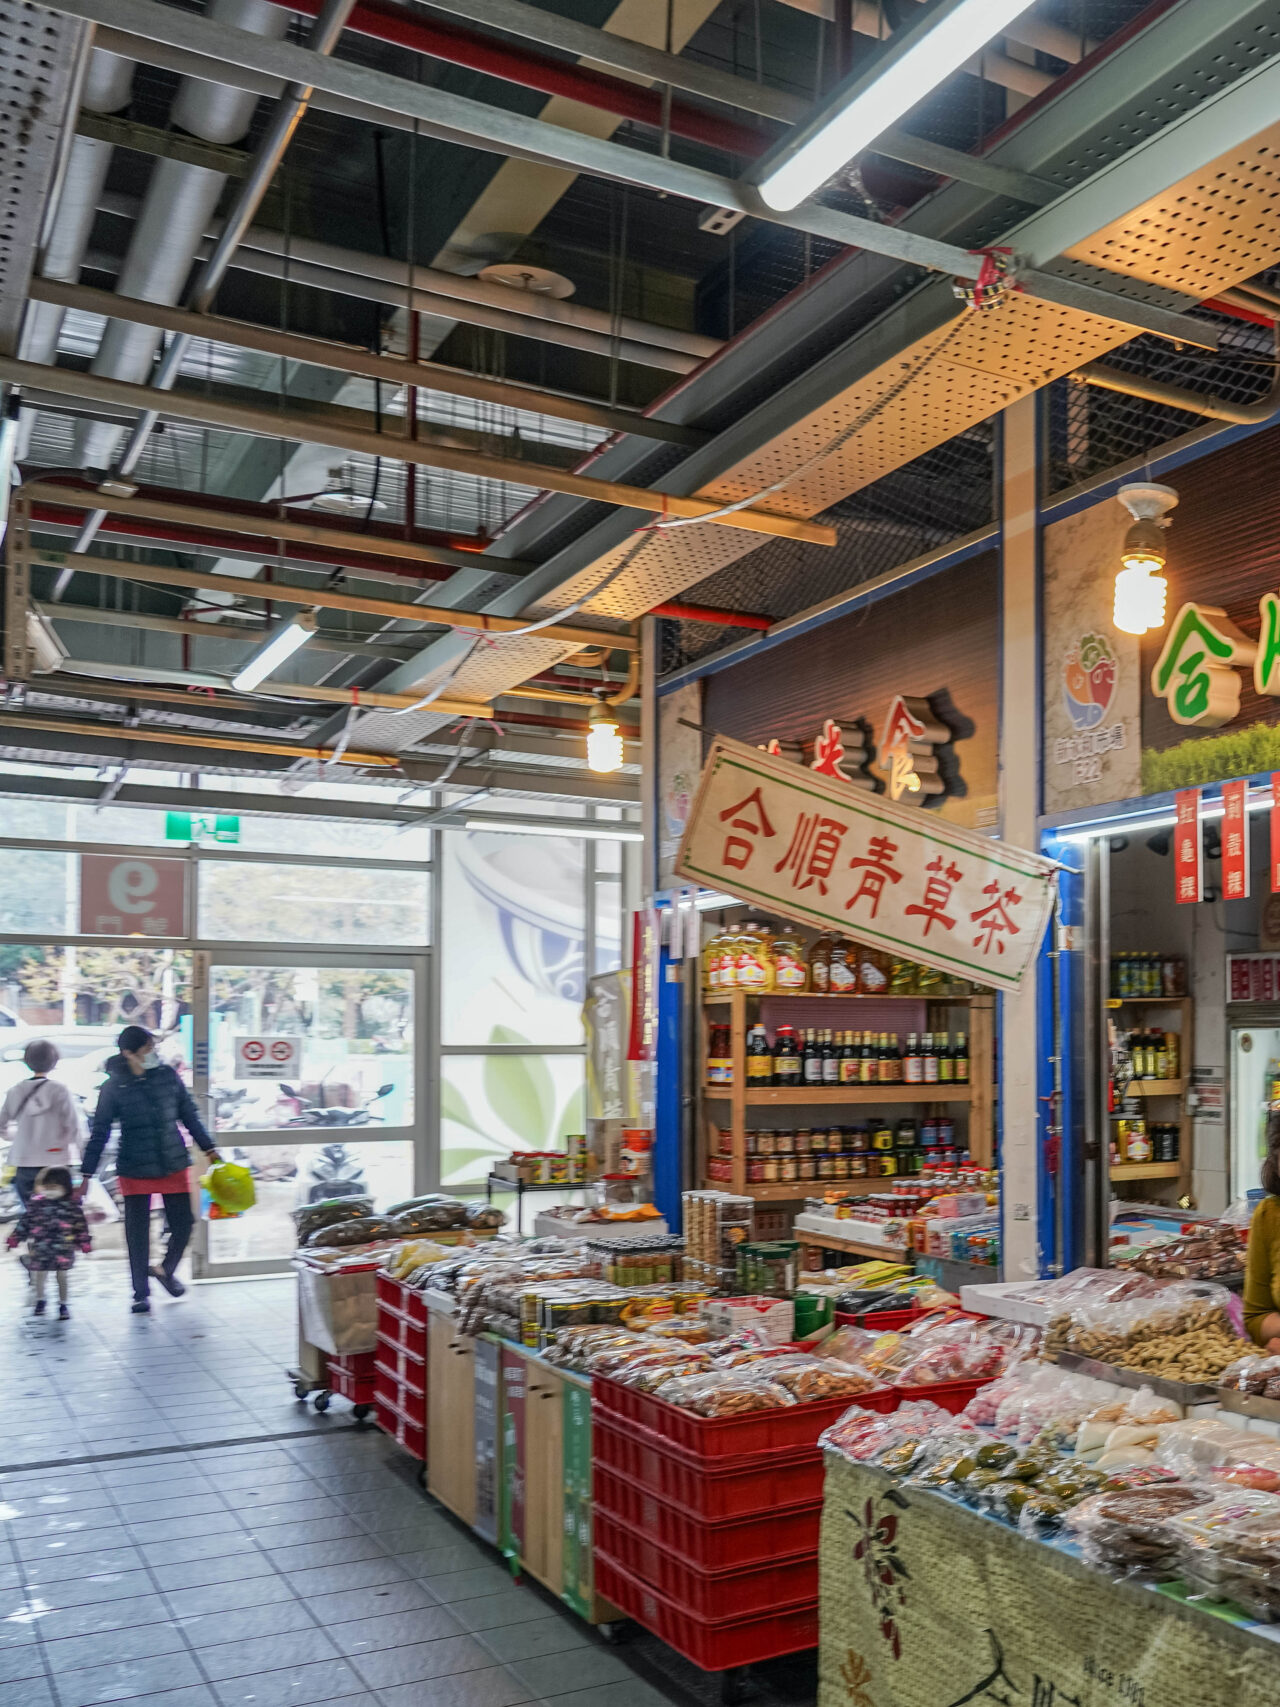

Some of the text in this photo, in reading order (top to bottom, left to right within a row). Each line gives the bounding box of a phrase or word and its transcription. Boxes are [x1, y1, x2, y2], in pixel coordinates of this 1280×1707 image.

[719, 787, 1024, 955] 合順青草茶
